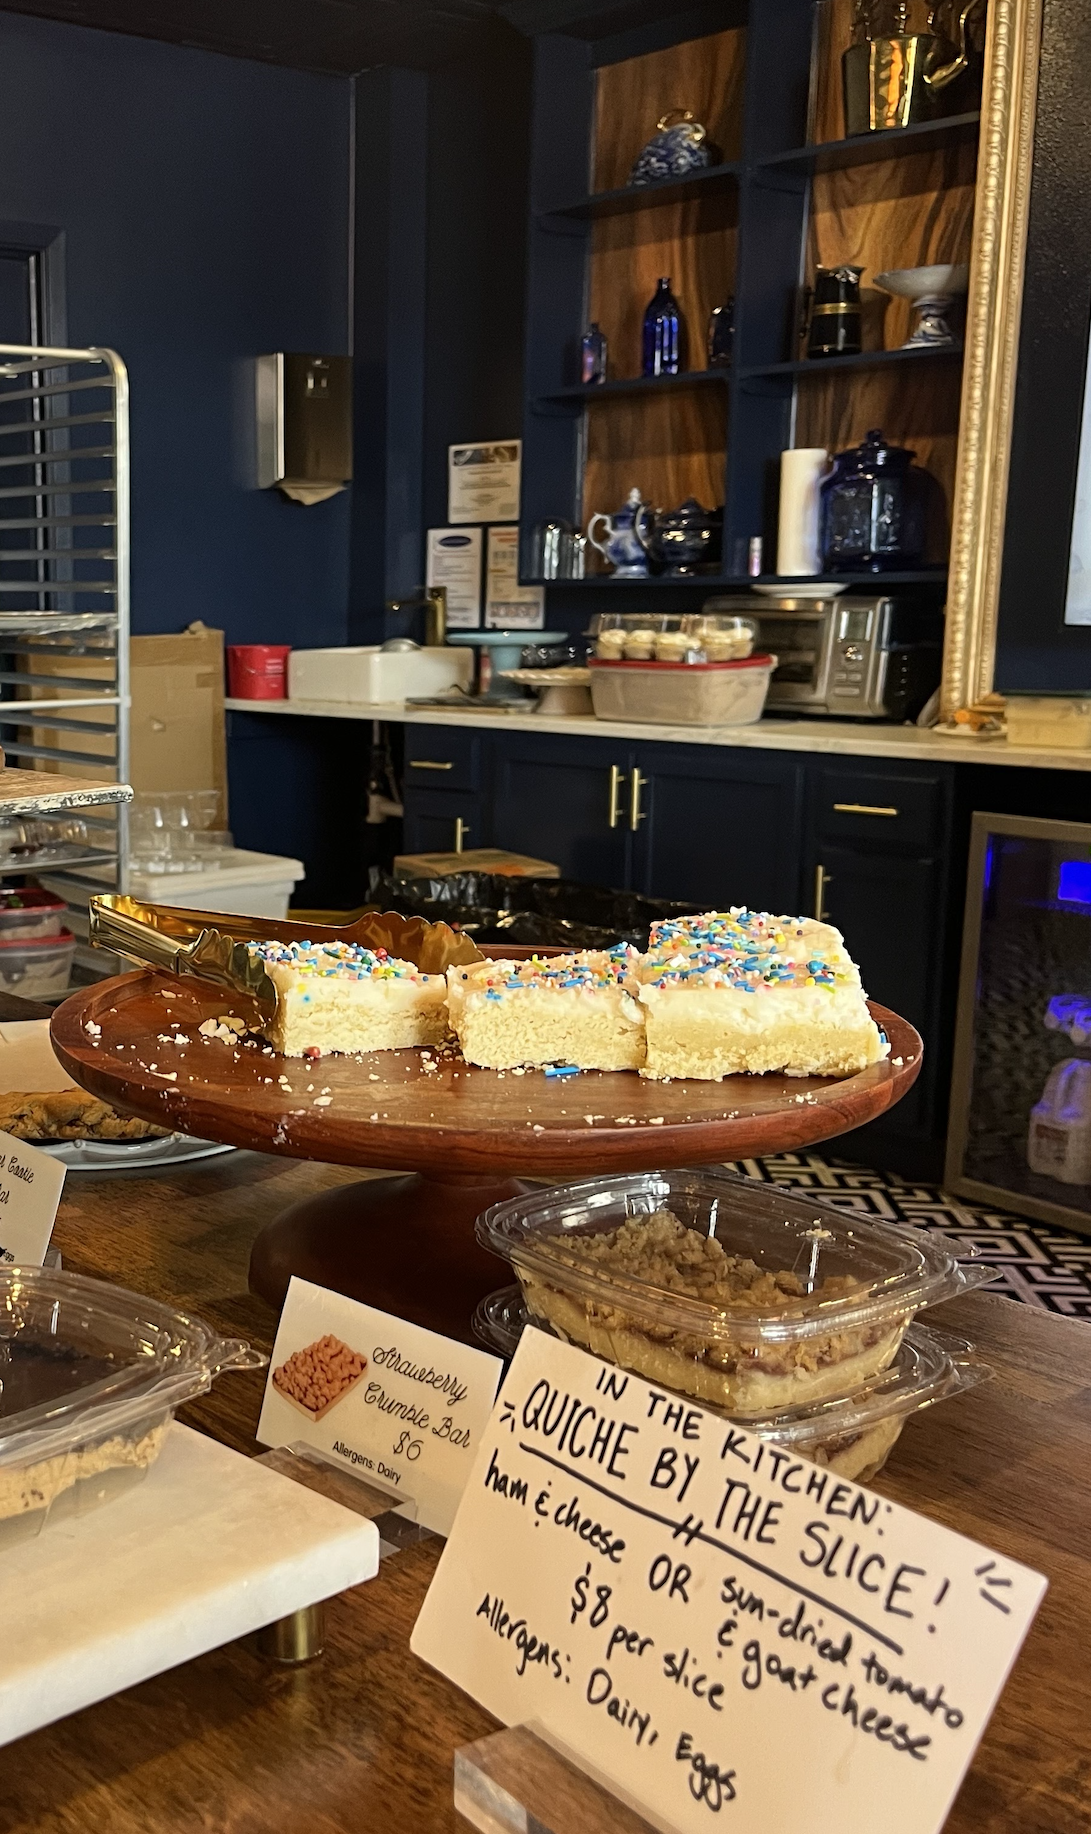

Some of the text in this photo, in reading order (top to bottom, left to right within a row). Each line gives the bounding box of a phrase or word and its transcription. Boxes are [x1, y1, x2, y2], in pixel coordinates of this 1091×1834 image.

[7, 1156, 35, 1184] Cookie
[364, 1381, 471, 1449] Crumble Bar
[372, 1346, 468, 1406] Strawberry
[332, 1440, 401, 1485] Allergens: Dairy
[393, 1431, 424, 1461] $6
[596, 1367, 892, 1536] IN THE KITCHEN:
[520, 1379, 951, 1634] QUICHE BY THE SLICE!
[483, 1447, 530, 1504] ham
[553, 1489, 626, 1564] cheese
[649, 1555, 692, 1603] OR
[721, 1574, 852, 1669] sun-dried
[861, 1648, 964, 1729] tomato
[570, 1562, 725, 1713] $8 per slice
[477, 1593, 738, 1813] Allergens: Dairy, Eggs
[741, 1643, 816, 1691] goat
[820, 1681, 932, 1761] cheese
